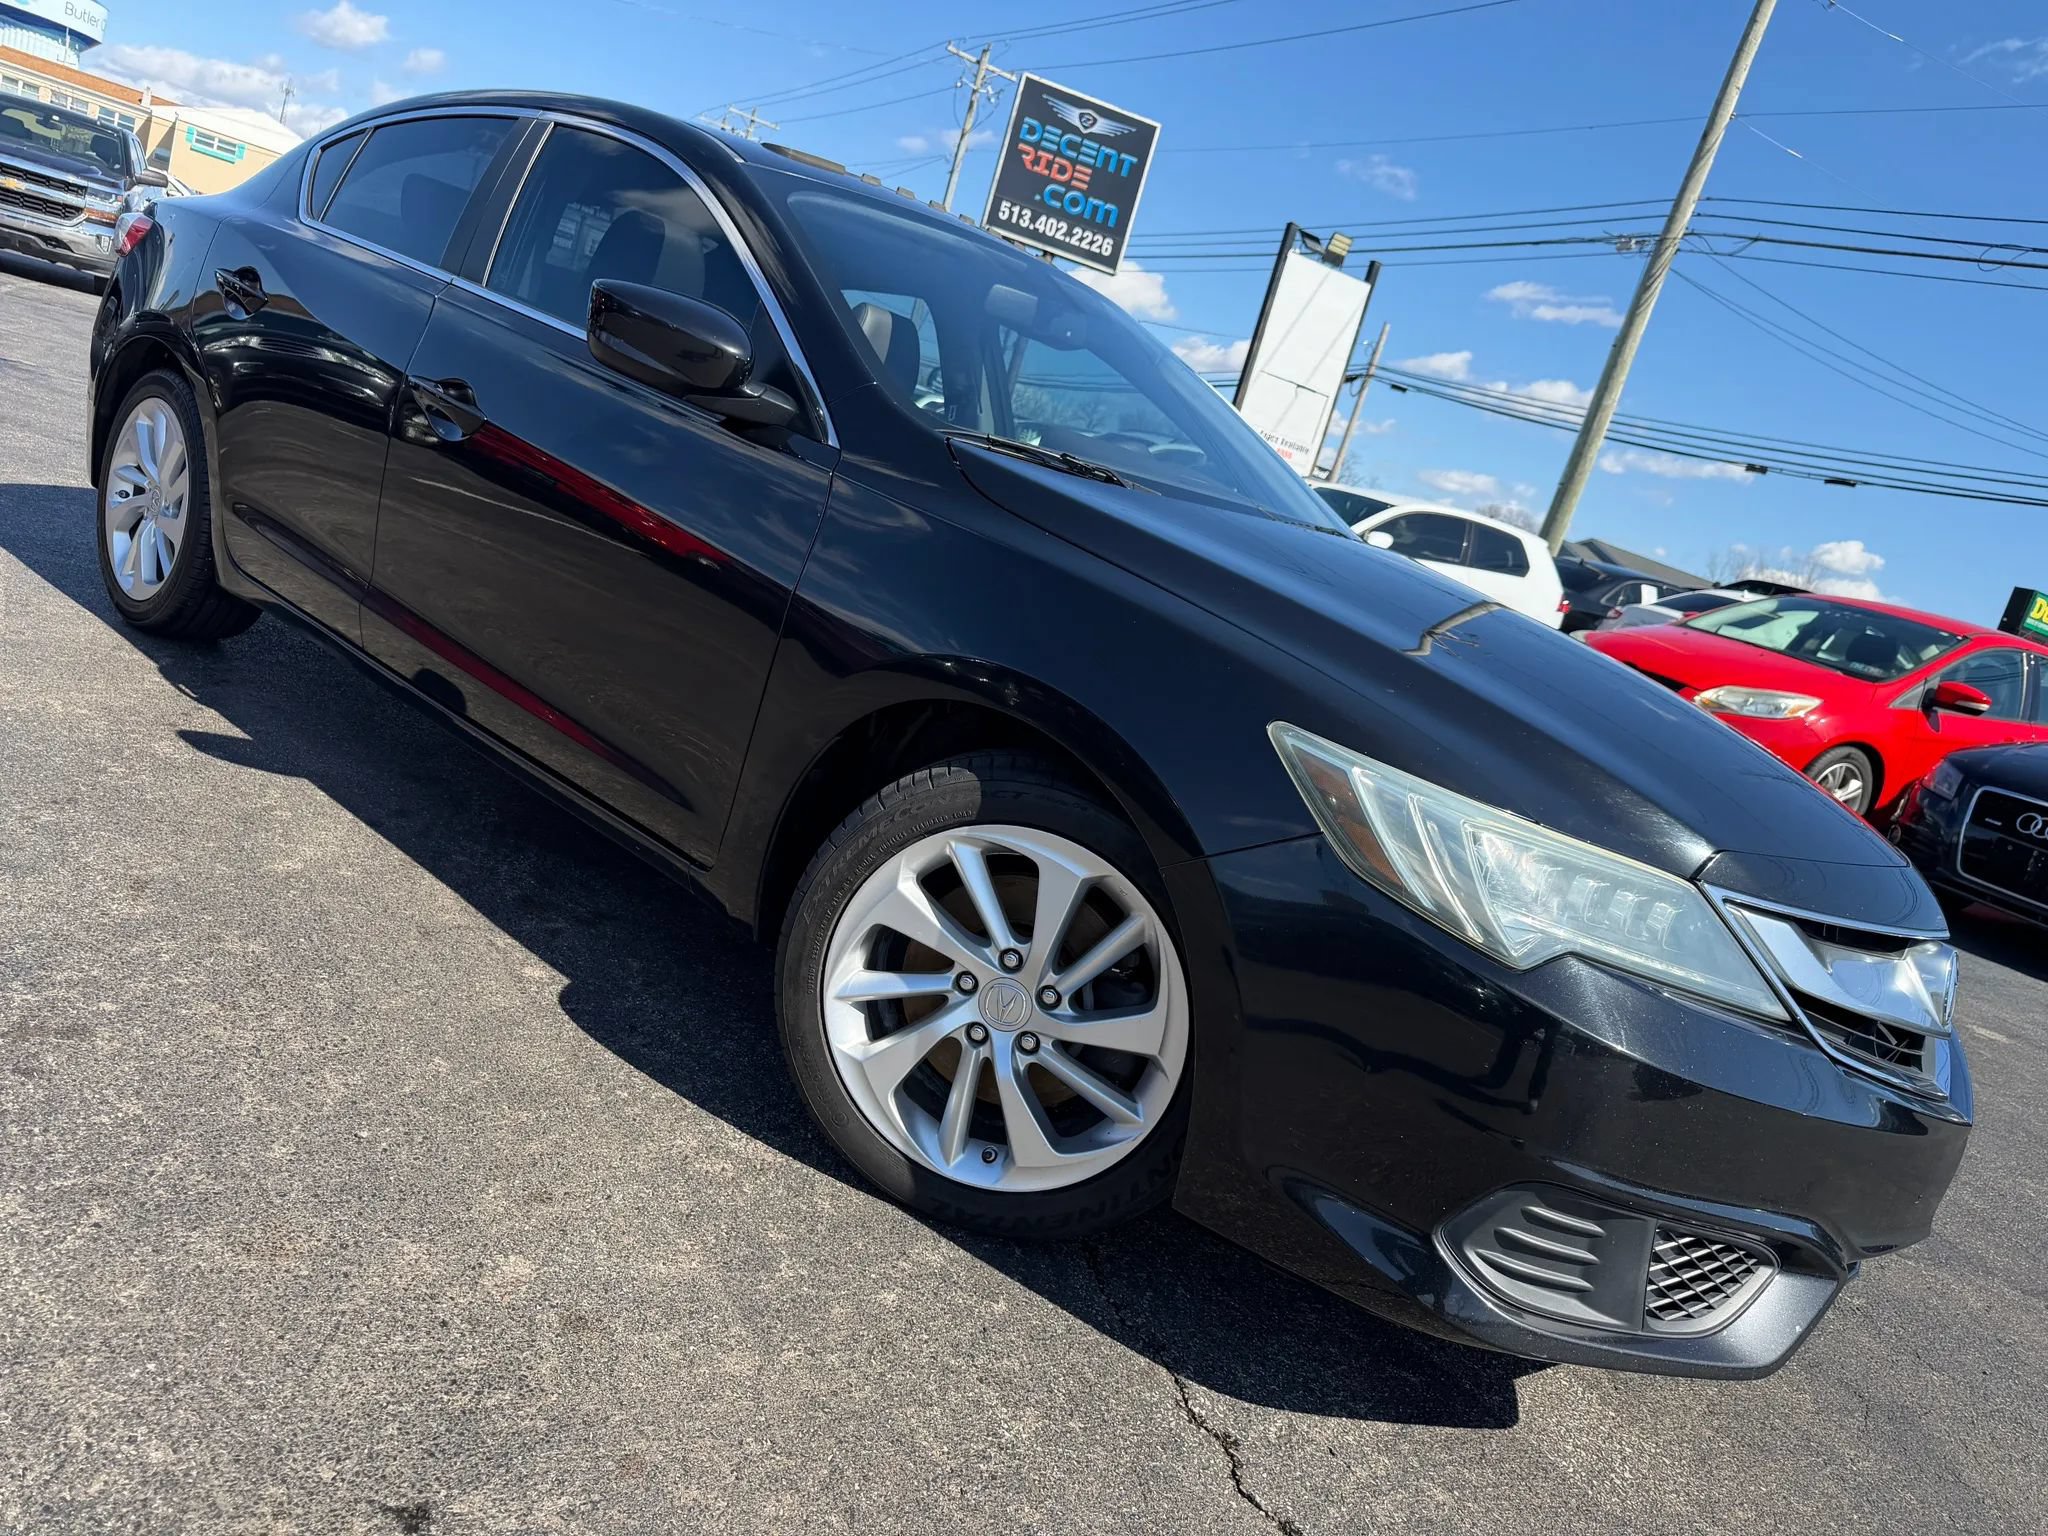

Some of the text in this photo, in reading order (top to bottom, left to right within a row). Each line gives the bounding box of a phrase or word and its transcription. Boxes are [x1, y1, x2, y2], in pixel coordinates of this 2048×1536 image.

[64, 1, 100, 28] Butler
[1017, 143, 1093, 190] RIDE
[998, 200, 1113, 257] 513.402.2226
